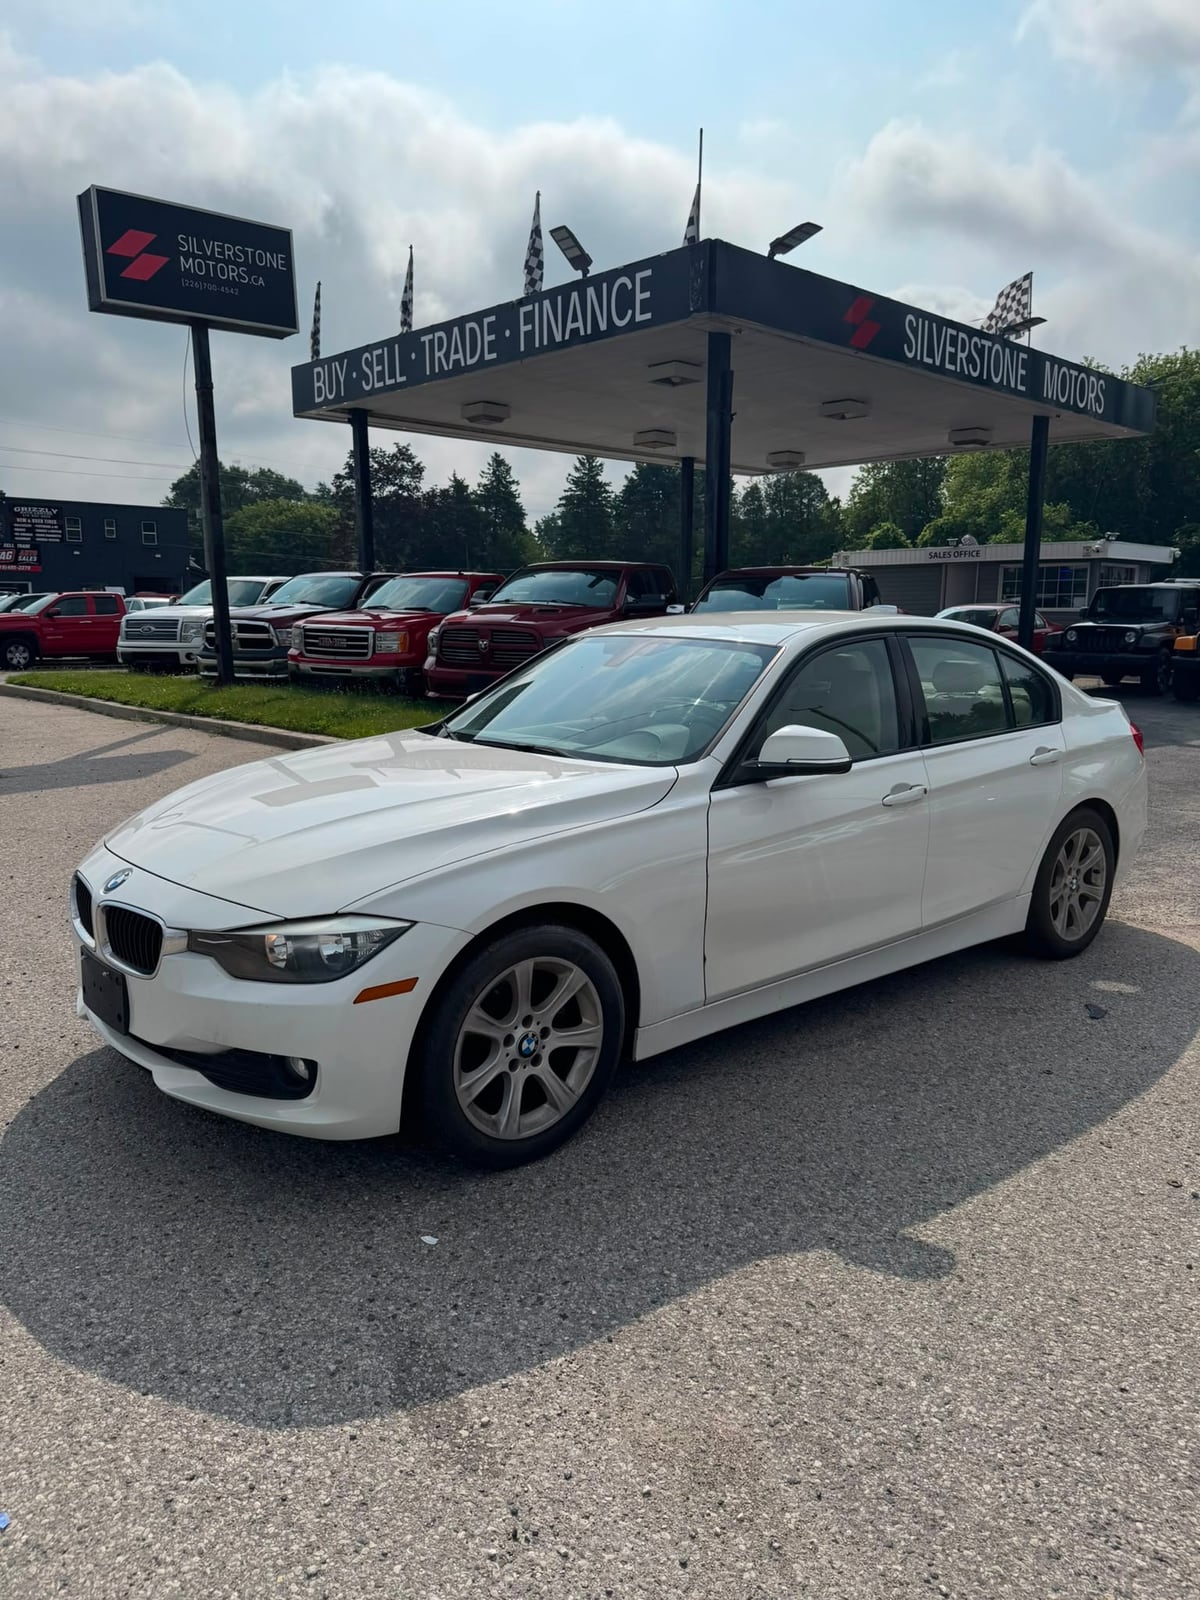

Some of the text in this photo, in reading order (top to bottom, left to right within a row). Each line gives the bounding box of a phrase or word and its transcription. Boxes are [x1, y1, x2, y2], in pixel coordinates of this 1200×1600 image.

[177, 234, 287, 271] SILVERSTONE
[180, 255, 265, 287] MOTORS.CA
[313, 268, 653, 404] BUY SELL TRADE FINANCE
[903, 313, 1106, 414] SILVERSTONE MOTORS
[14, 506, 58, 515] GRIZZLY
[0, 551, 13, 560] AG
[928, 549, 981, 560] SALES OFFICE
